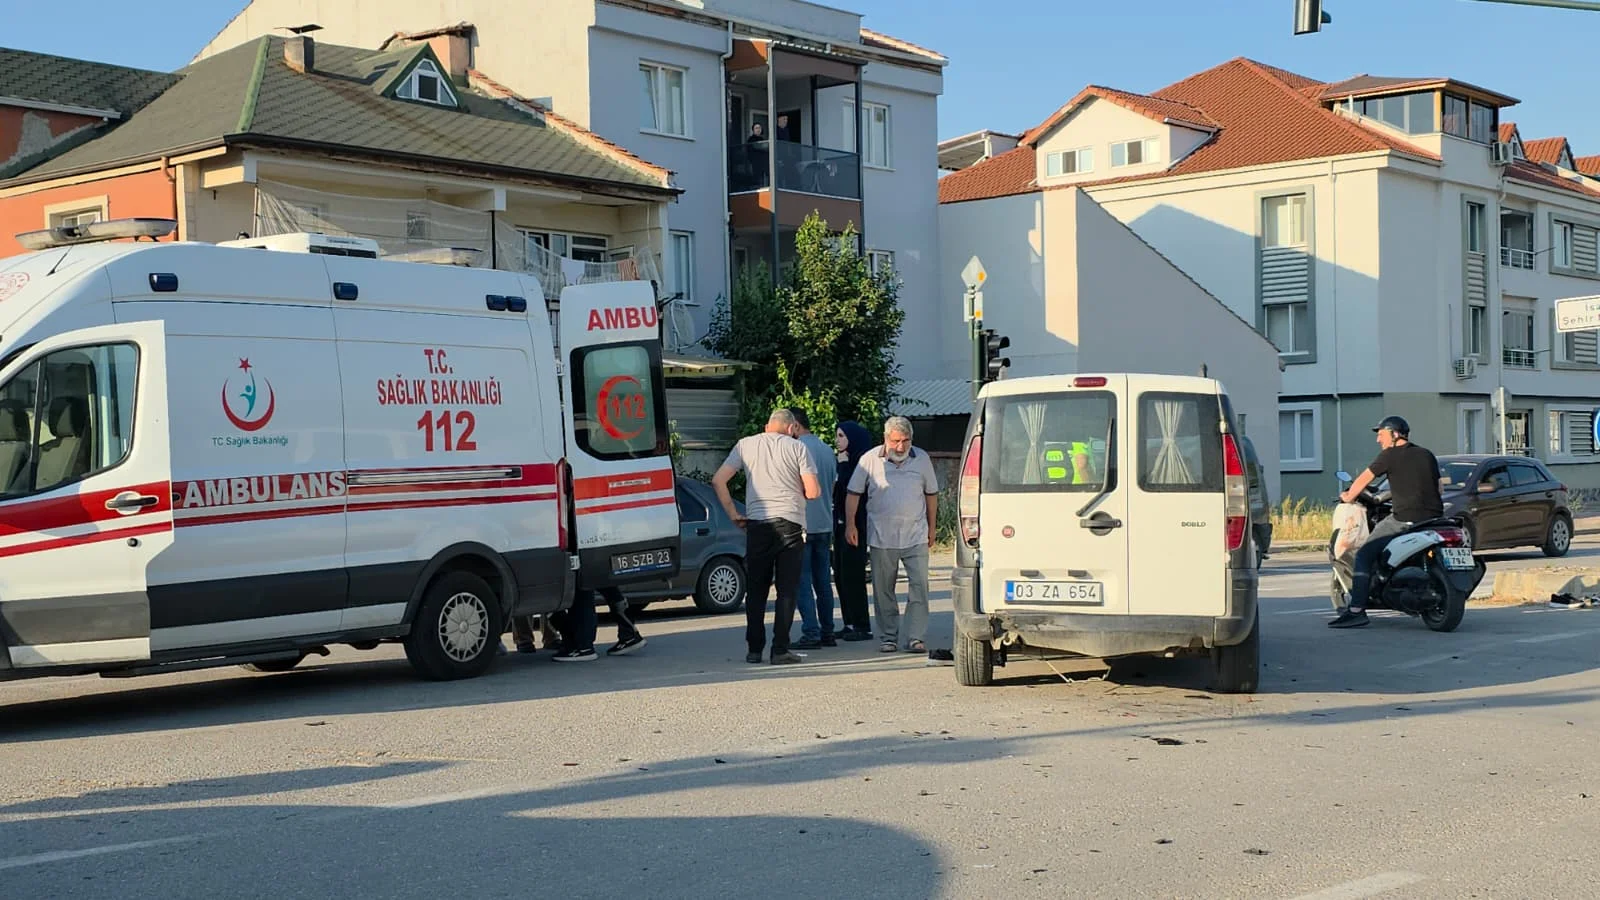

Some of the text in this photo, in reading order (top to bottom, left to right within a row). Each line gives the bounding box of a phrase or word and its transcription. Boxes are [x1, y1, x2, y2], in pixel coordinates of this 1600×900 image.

[587, 306, 657, 331] AMBU
[424, 348, 453, 374] T.C.
[377, 374, 502, 405] SAĞLIK BAKANLIĞI
[611, 394, 646, 419] 112
[417, 410, 477, 451] 112
[183, 472, 346, 508] AMBULANS
[617, 551, 670, 569] 16 SZB 23
[1015, 584, 1096, 599] 03 ZA 654
